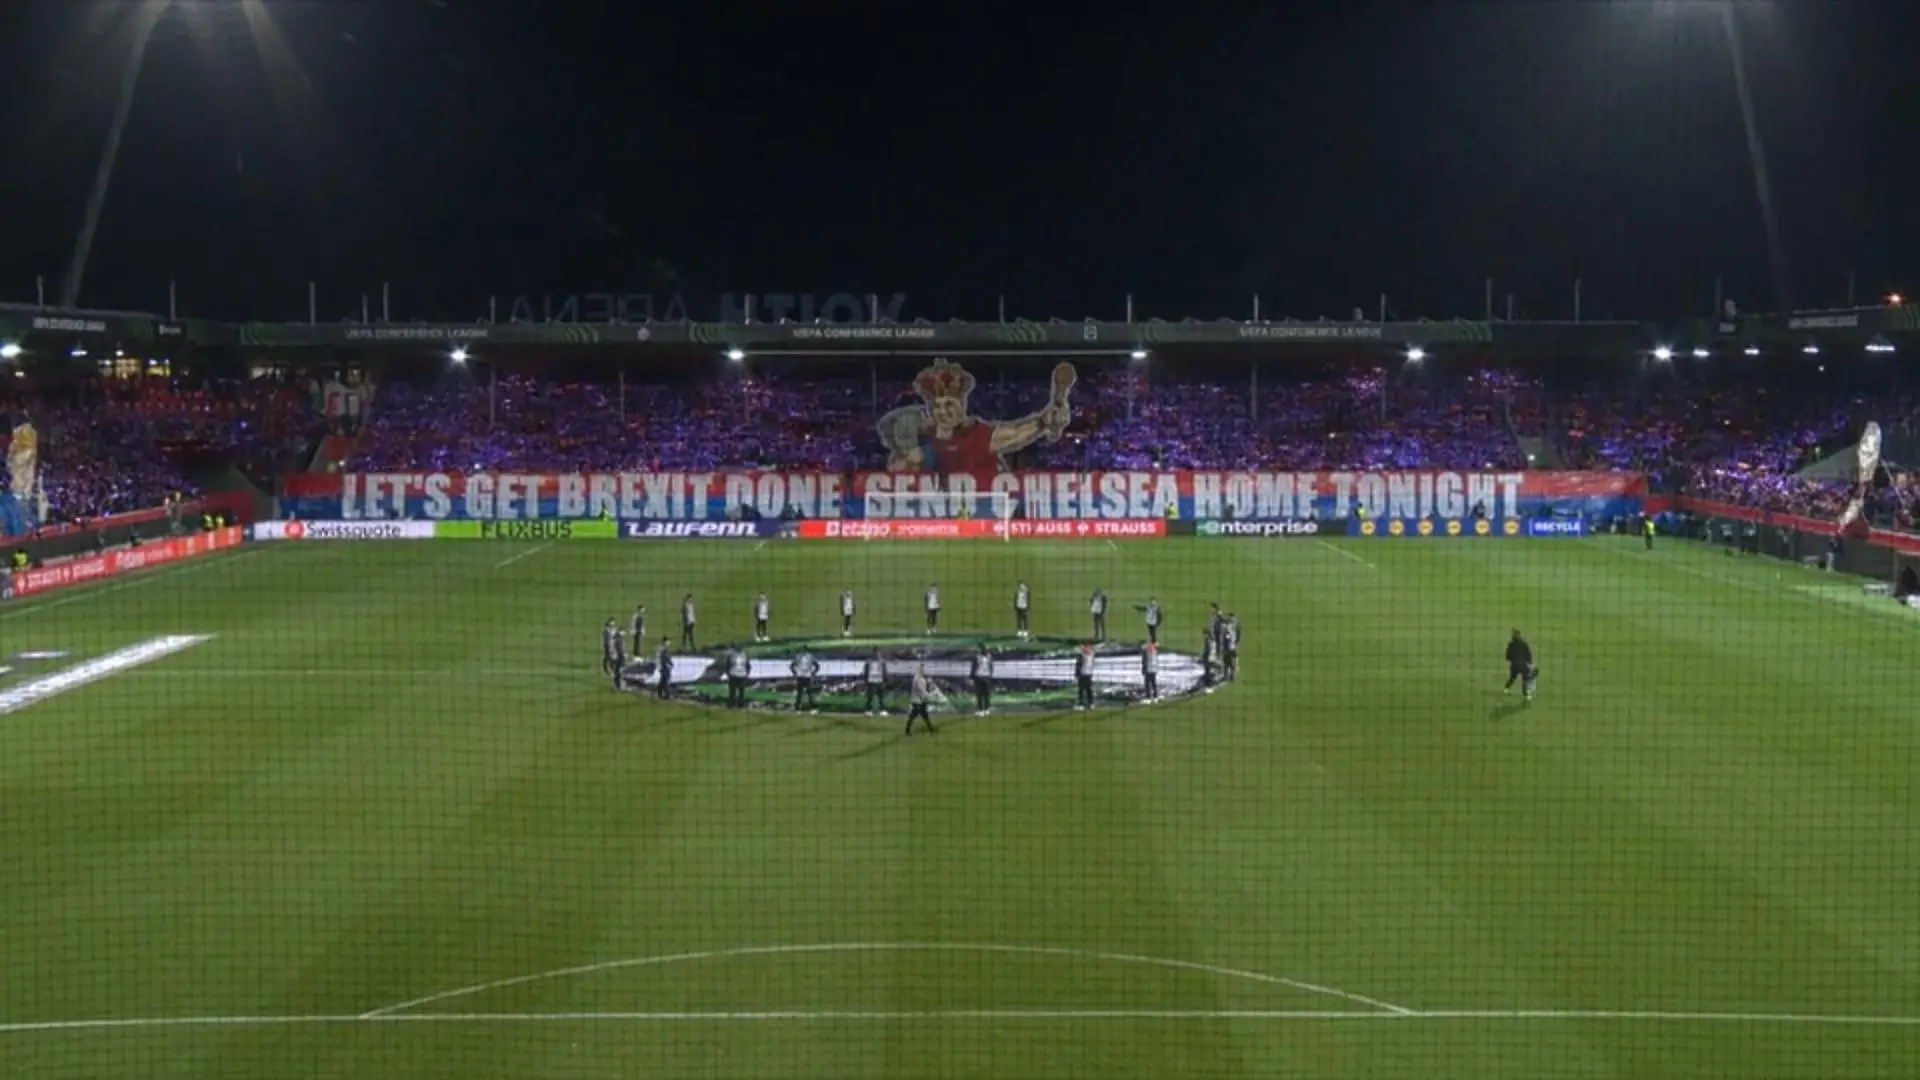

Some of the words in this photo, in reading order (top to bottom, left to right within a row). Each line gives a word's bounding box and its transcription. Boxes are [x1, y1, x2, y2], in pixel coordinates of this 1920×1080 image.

[341, 473, 452, 519] LET'S
[465, 473, 541, 519] GET
[557, 472, 714, 519] BREXIT
[724, 472, 841, 518] DONE
[865, 472, 977, 518] SEND
[991, 472, 1180, 519] CHELSEA
[1193, 472, 1318, 519] HOME
[1330, 471, 1523, 519] TONIGHT
[307, 521, 401, 538] Swissquote
[482, 520, 573, 538] FLIXBUS
[1096, 521, 1157, 534] STRAUSS
[1200, 519, 1318, 536] enterprise
